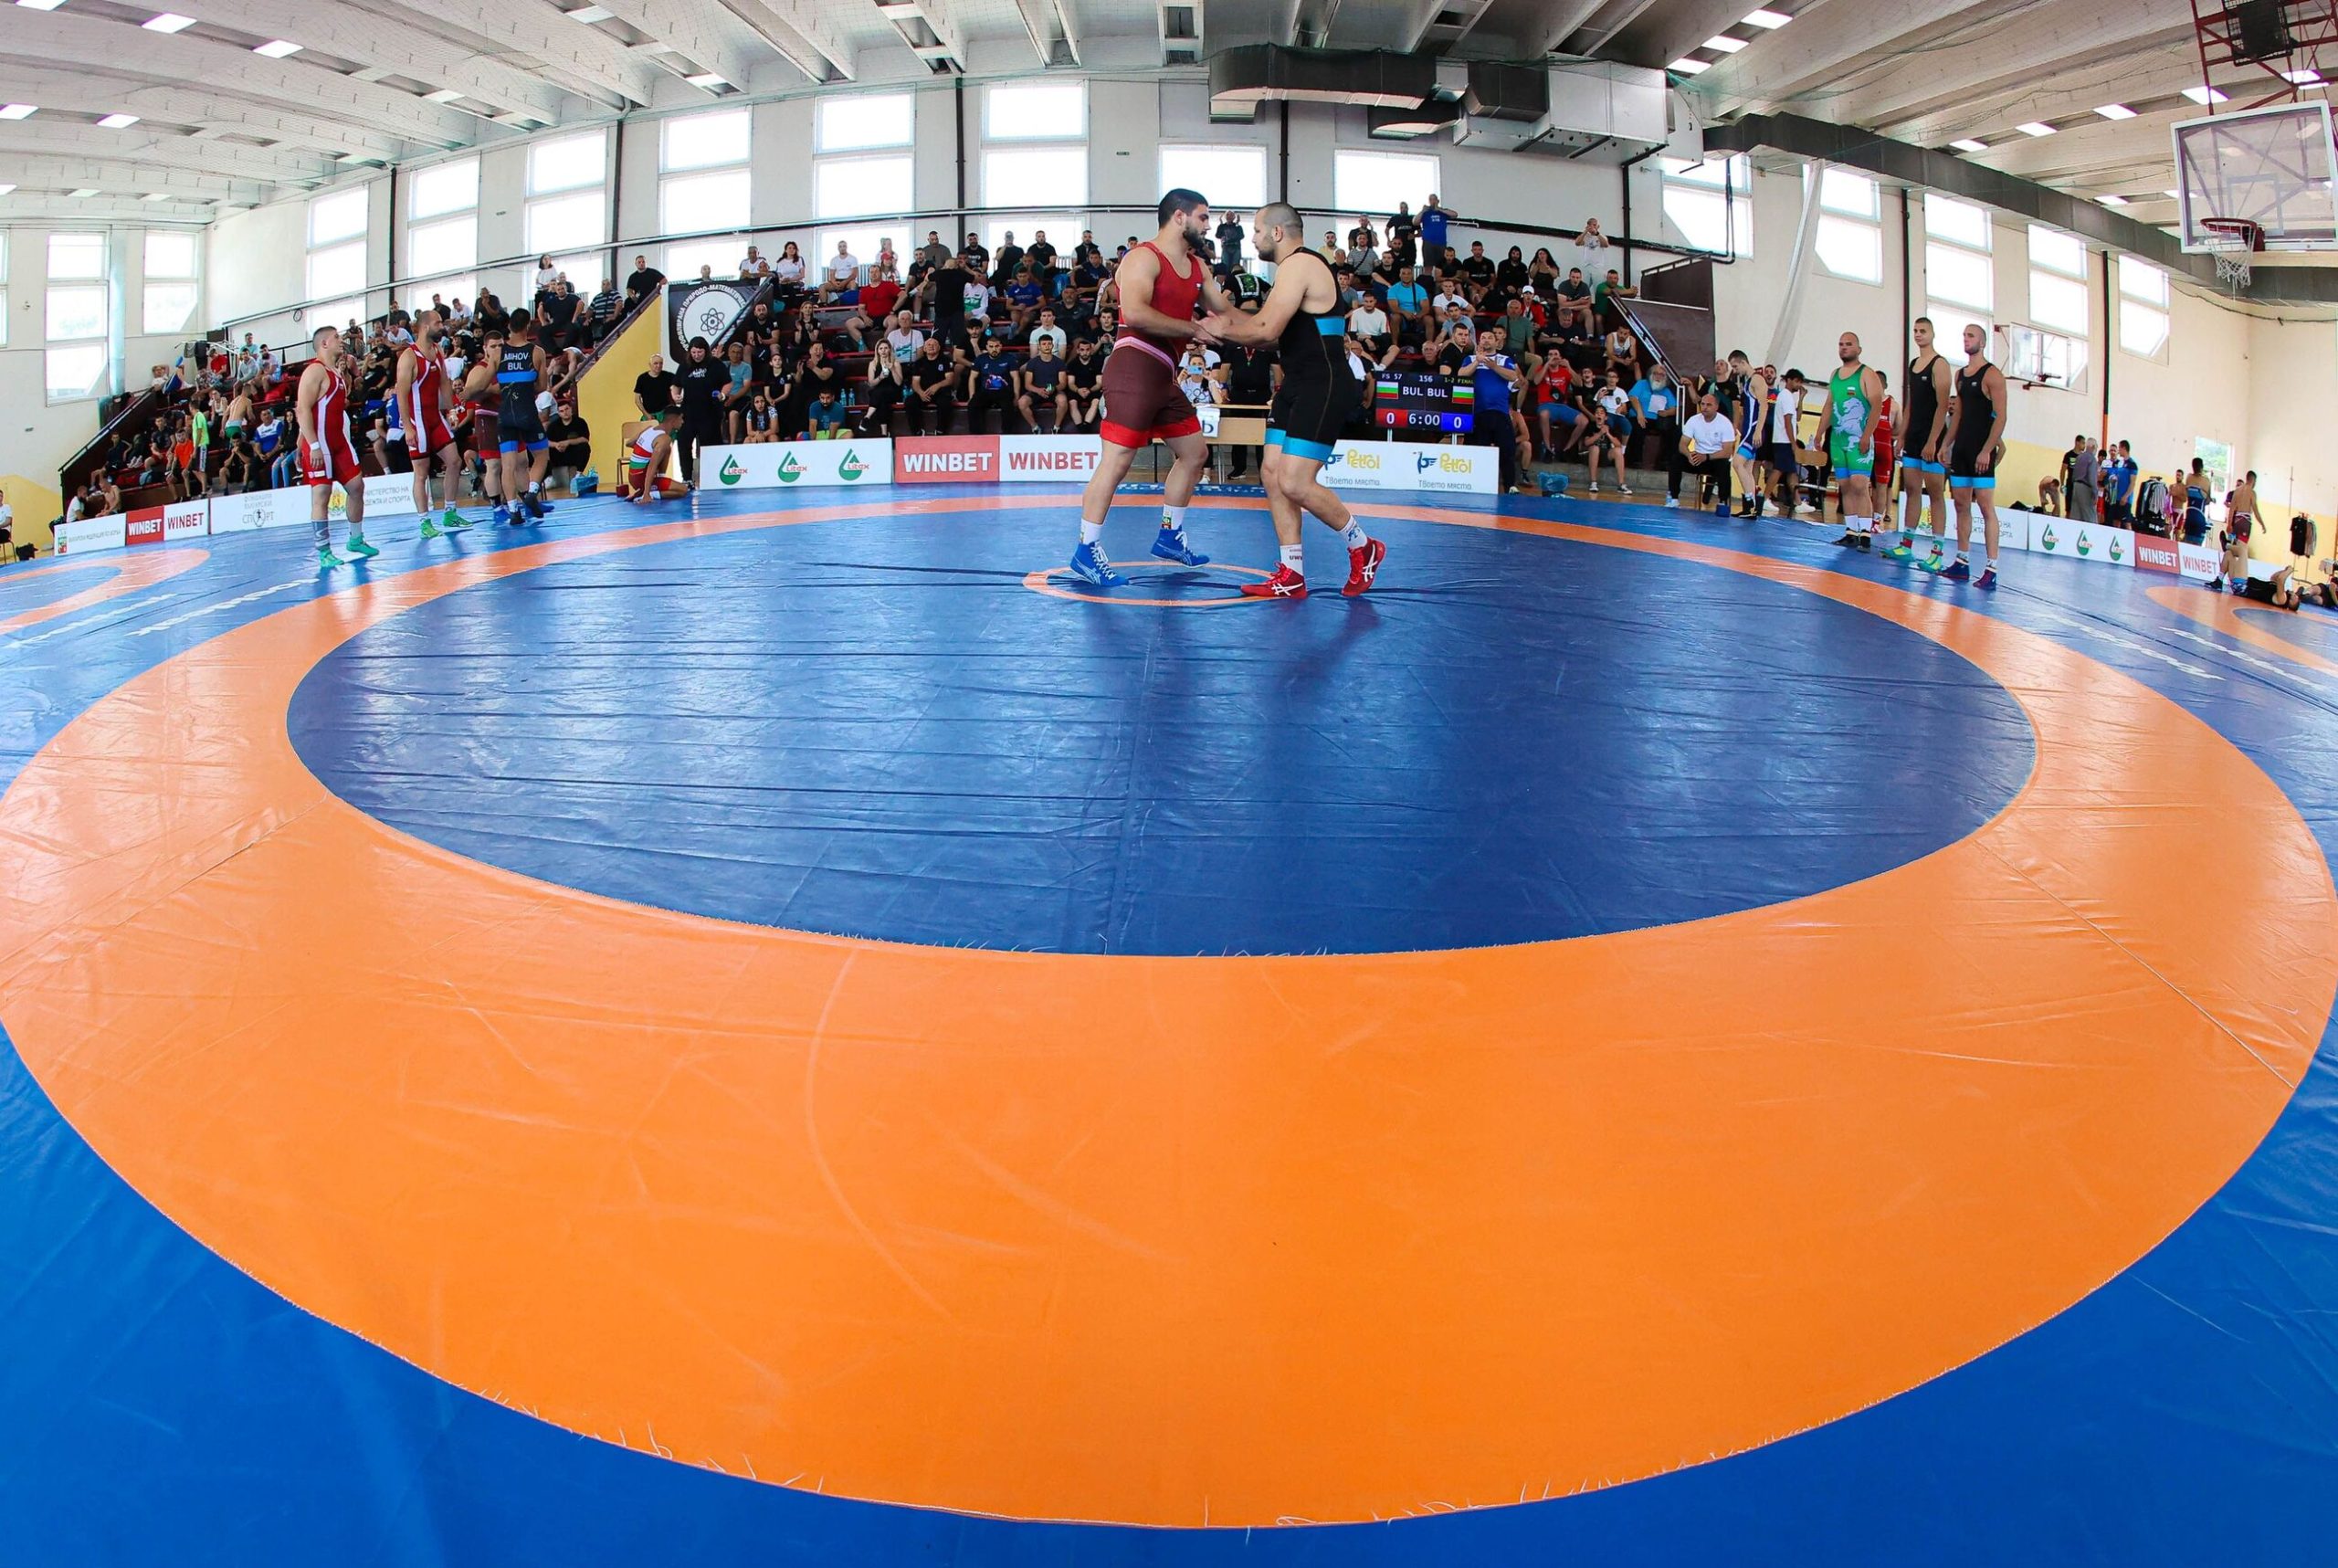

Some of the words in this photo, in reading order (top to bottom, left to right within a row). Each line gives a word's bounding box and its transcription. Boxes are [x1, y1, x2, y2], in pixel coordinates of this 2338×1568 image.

[503, 353, 529, 361] MIHOV
[508, 362, 524, 371] BUL
[1418, 374, 1434, 383] 156
[1403, 386, 1424, 396] BUL
[1427, 388, 1448, 398] BUL
[1386, 412, 1395, 425] 0
[1408, 413, 1440, 426] 6:00
[1453, 416, 1462, 428] 0
[902, 452, 994, 473] WINBET
[1008, 451, 1099, 470] WINBET
[128, 518, 163, 537] WINBET
[167, 512, 205, 530] WINBET
[2138, 546, 2177, 567] WINBET
[2183, 555, 2217, 575] WINBET
